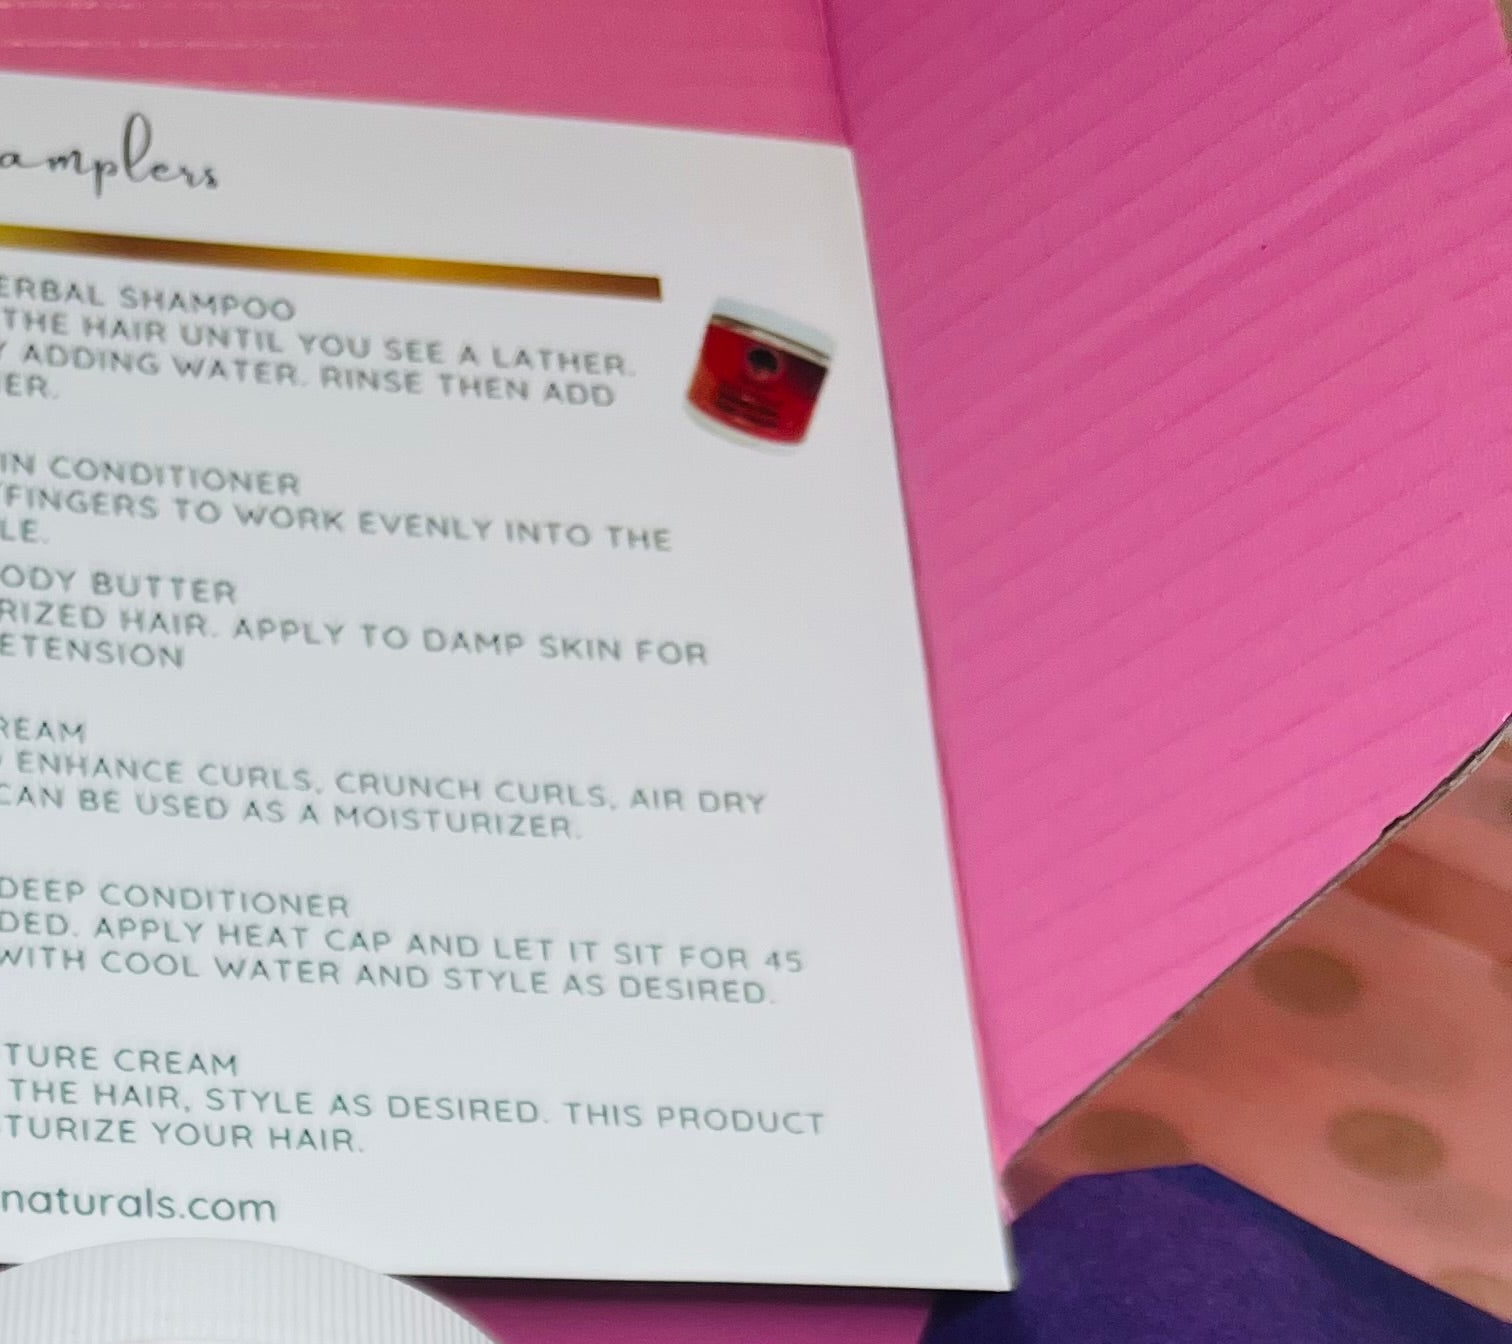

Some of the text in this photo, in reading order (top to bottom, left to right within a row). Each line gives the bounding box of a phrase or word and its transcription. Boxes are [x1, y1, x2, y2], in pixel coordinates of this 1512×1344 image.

[120, 285, 296, 321] SHAMPOO
[0, 451, 36, 475] IN
[49, 455, 300, 495] CONDITIONER
[90, 569, 237, 605] BUTTER
[99, 881, 349, 917] CONDITIONER
[113, 1048, 238, 1077] CREAM
[8, 1078, 77, 1105] THE
[94, 1083, 191, 1113] HAIR,
[206, 1087, 314, 1115] STYLE
[329, 1093, 373, 1117] AS
[387, 1095, 548, 1124] DESIRED.
[563, 1101, 643, 1127] THIS
[657, 1105, 824, 1135] PRODUCT
[151, 1122, 253, 1149] YOUR
[268, 1127, 364, 1152] HAIR.
